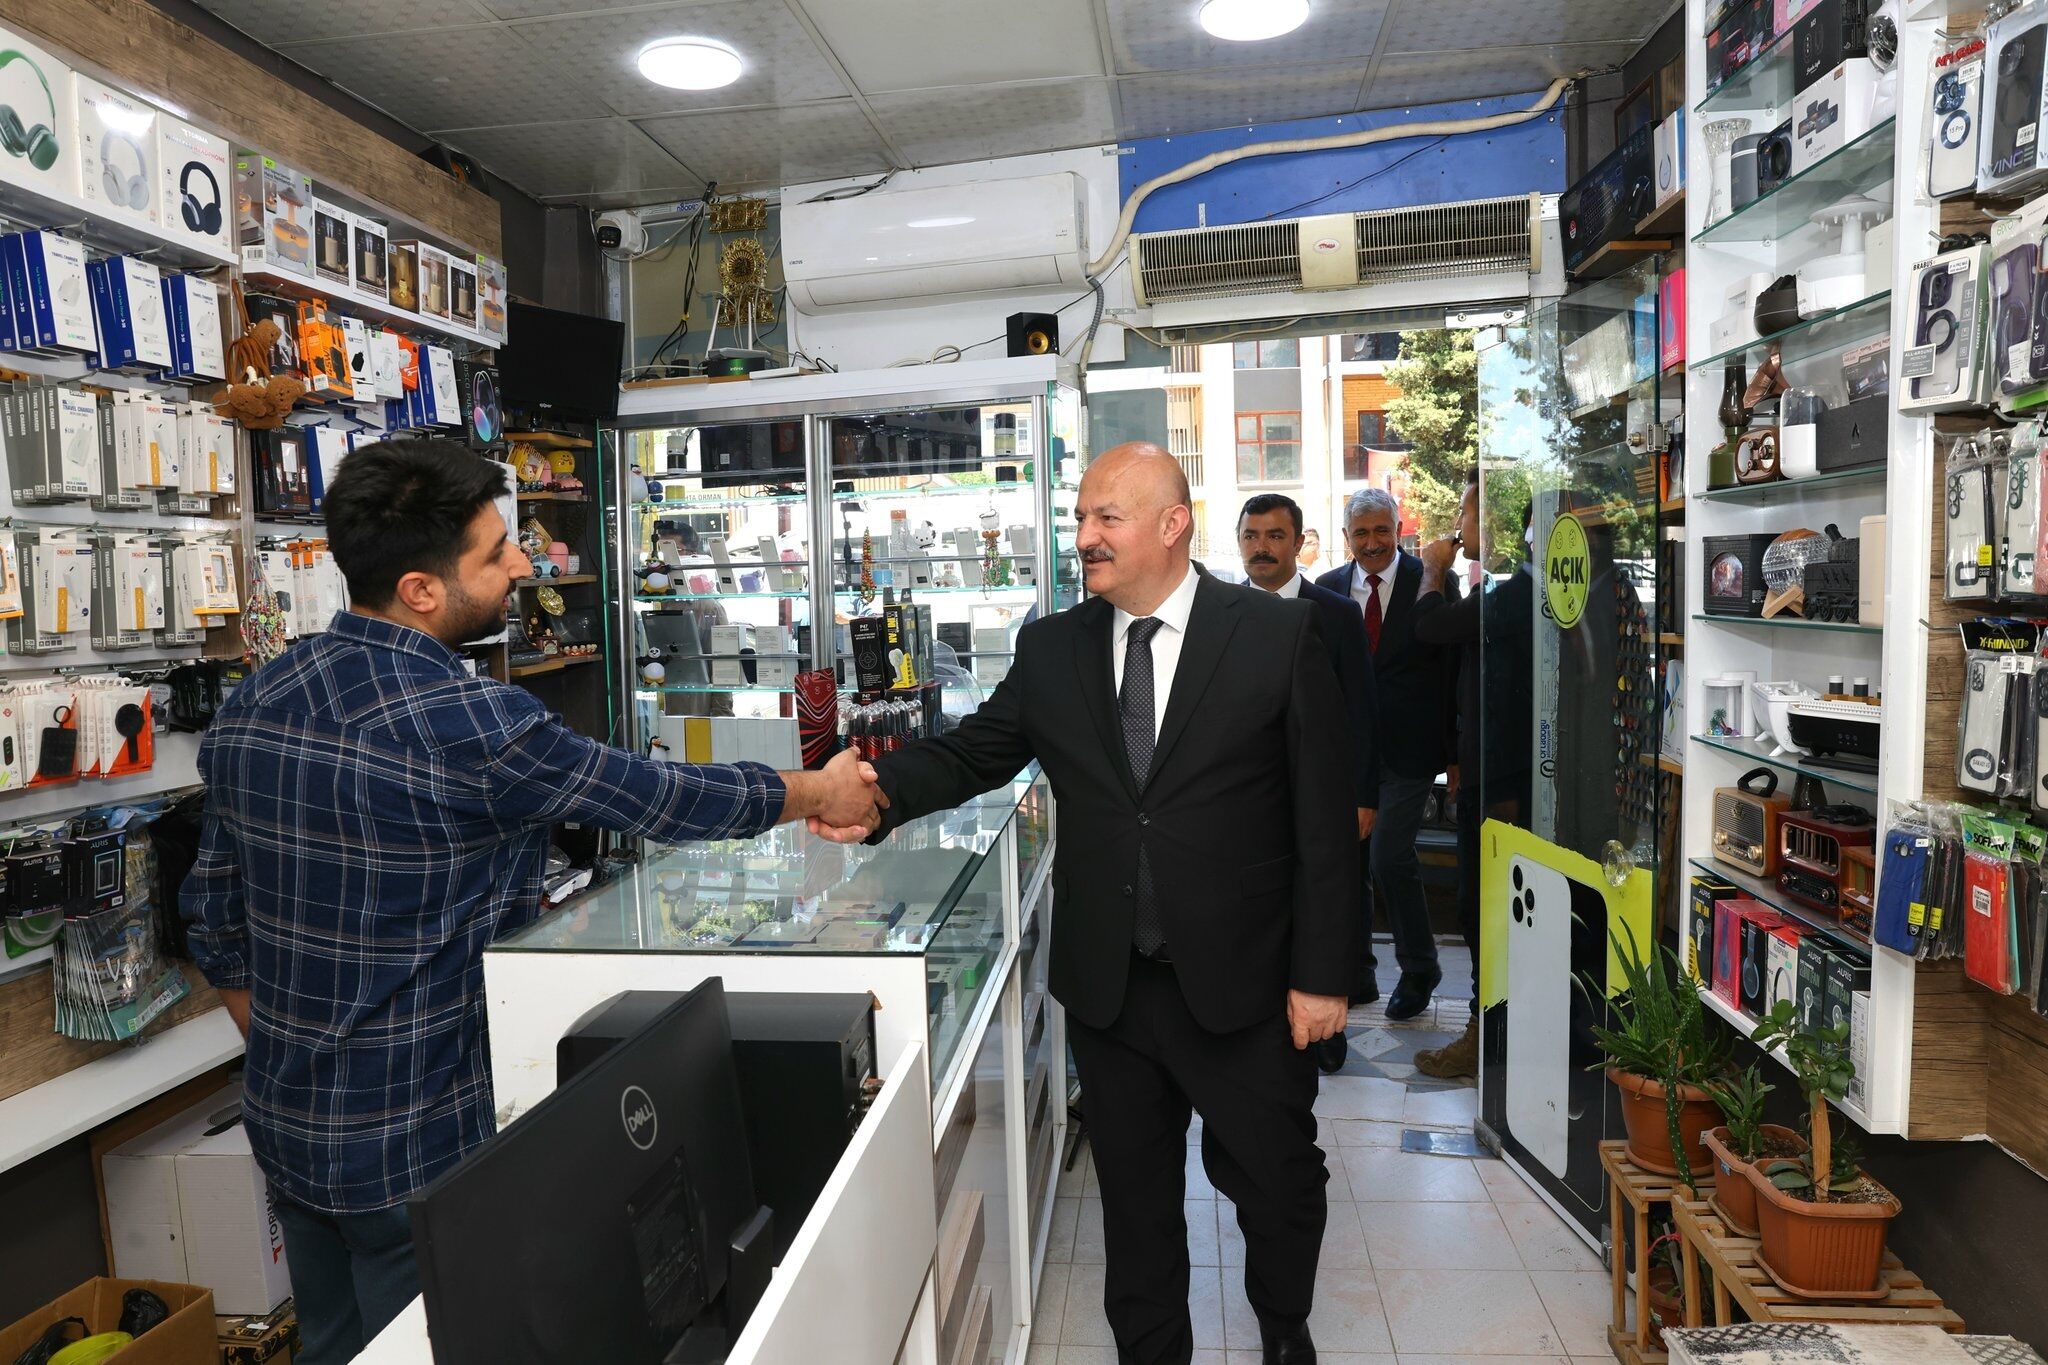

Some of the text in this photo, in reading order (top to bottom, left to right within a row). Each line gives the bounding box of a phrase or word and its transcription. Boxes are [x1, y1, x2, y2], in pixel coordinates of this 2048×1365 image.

[1550, 556, 1585, 593] AÇIK
[90, 840, 108, 849] AURIS
[23, 855, 60, 867] AURIS 1A
[1807, 951, 1822, 965] AURIS
[1837, 966, 1852, 982] AURIS
[628, 1104, 654, 1132] DELL
